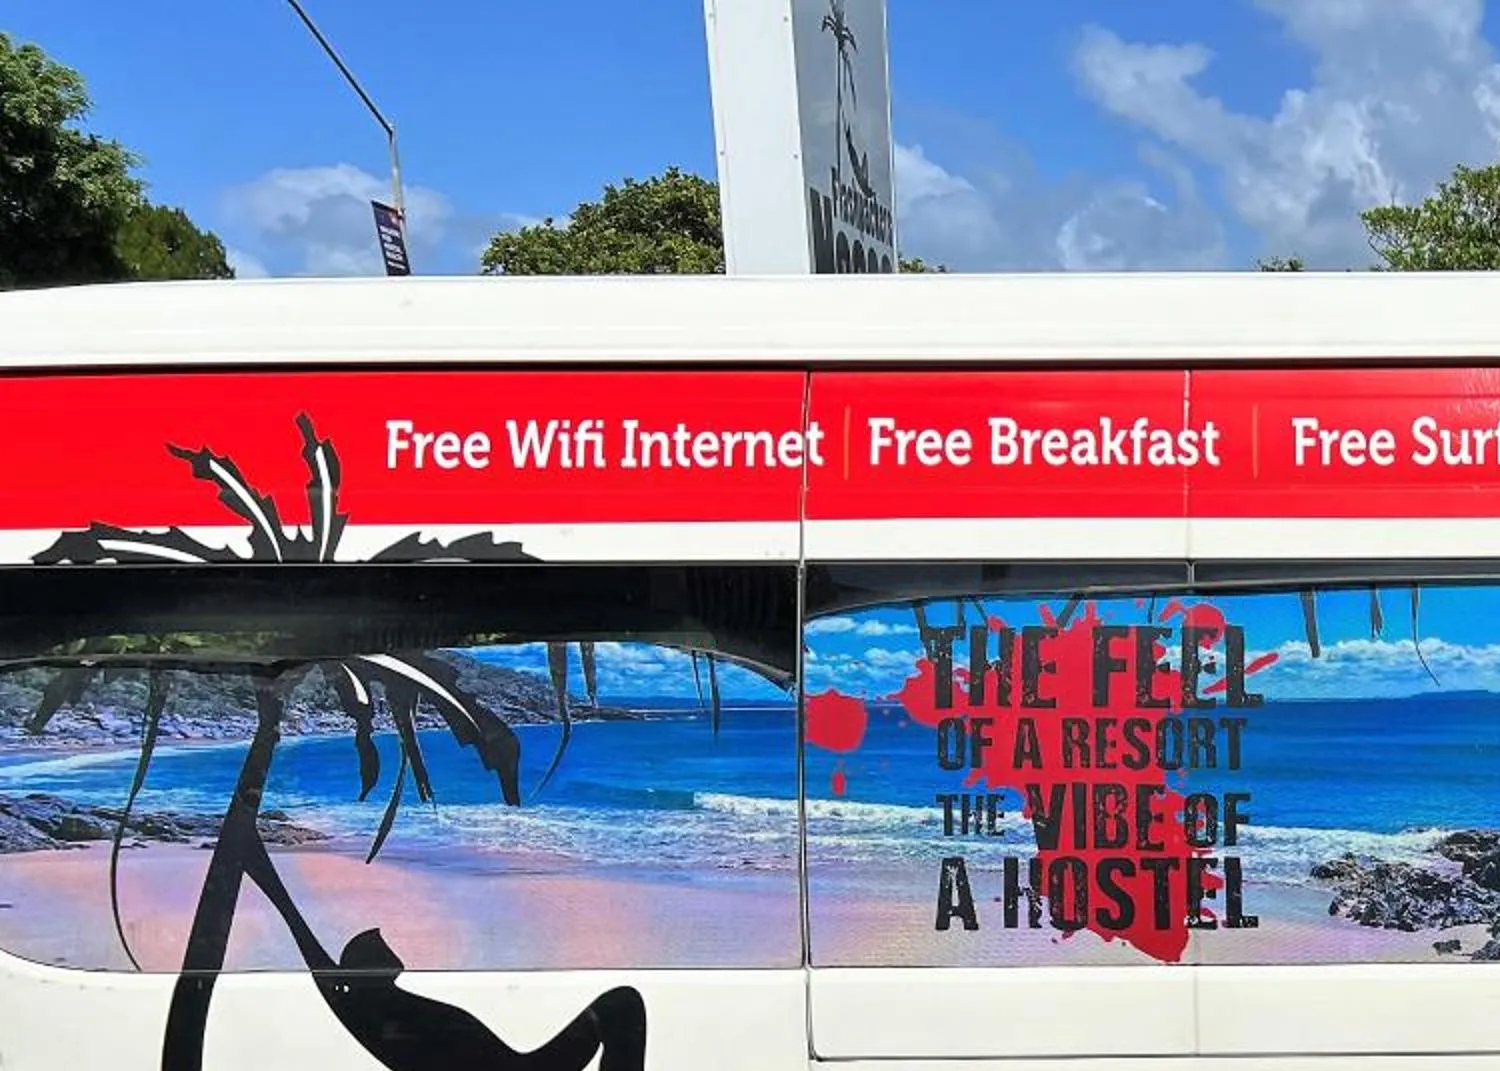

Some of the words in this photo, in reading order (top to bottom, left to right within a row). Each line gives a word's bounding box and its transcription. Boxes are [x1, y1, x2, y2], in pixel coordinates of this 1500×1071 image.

[385, 420, 491, 468] Free
[505, 419, 606, 468] Wifi
[620, 418, 825, 467] Internet
[868, 417, 972, 466] Free
[987, 417, 1221, 466] Breakfast
[1291, 416, 1396, 466] Free
[923, 625, 1057, 710] THE
[1092, 625, 1265, 710] FEEL
[937, 718, 994, 770] OF
[1012, 718, 1043, 770] A
[1061, 717, 1249, 771] RESORT
[935, 794, 1005, 836] THE
[1024, 783, 1167, 851] VIBE
[1183, 793, 1252, 848] OF
[935, 857, 979, 931] A
[1003, 857, 1260, 931] HOSTEL
